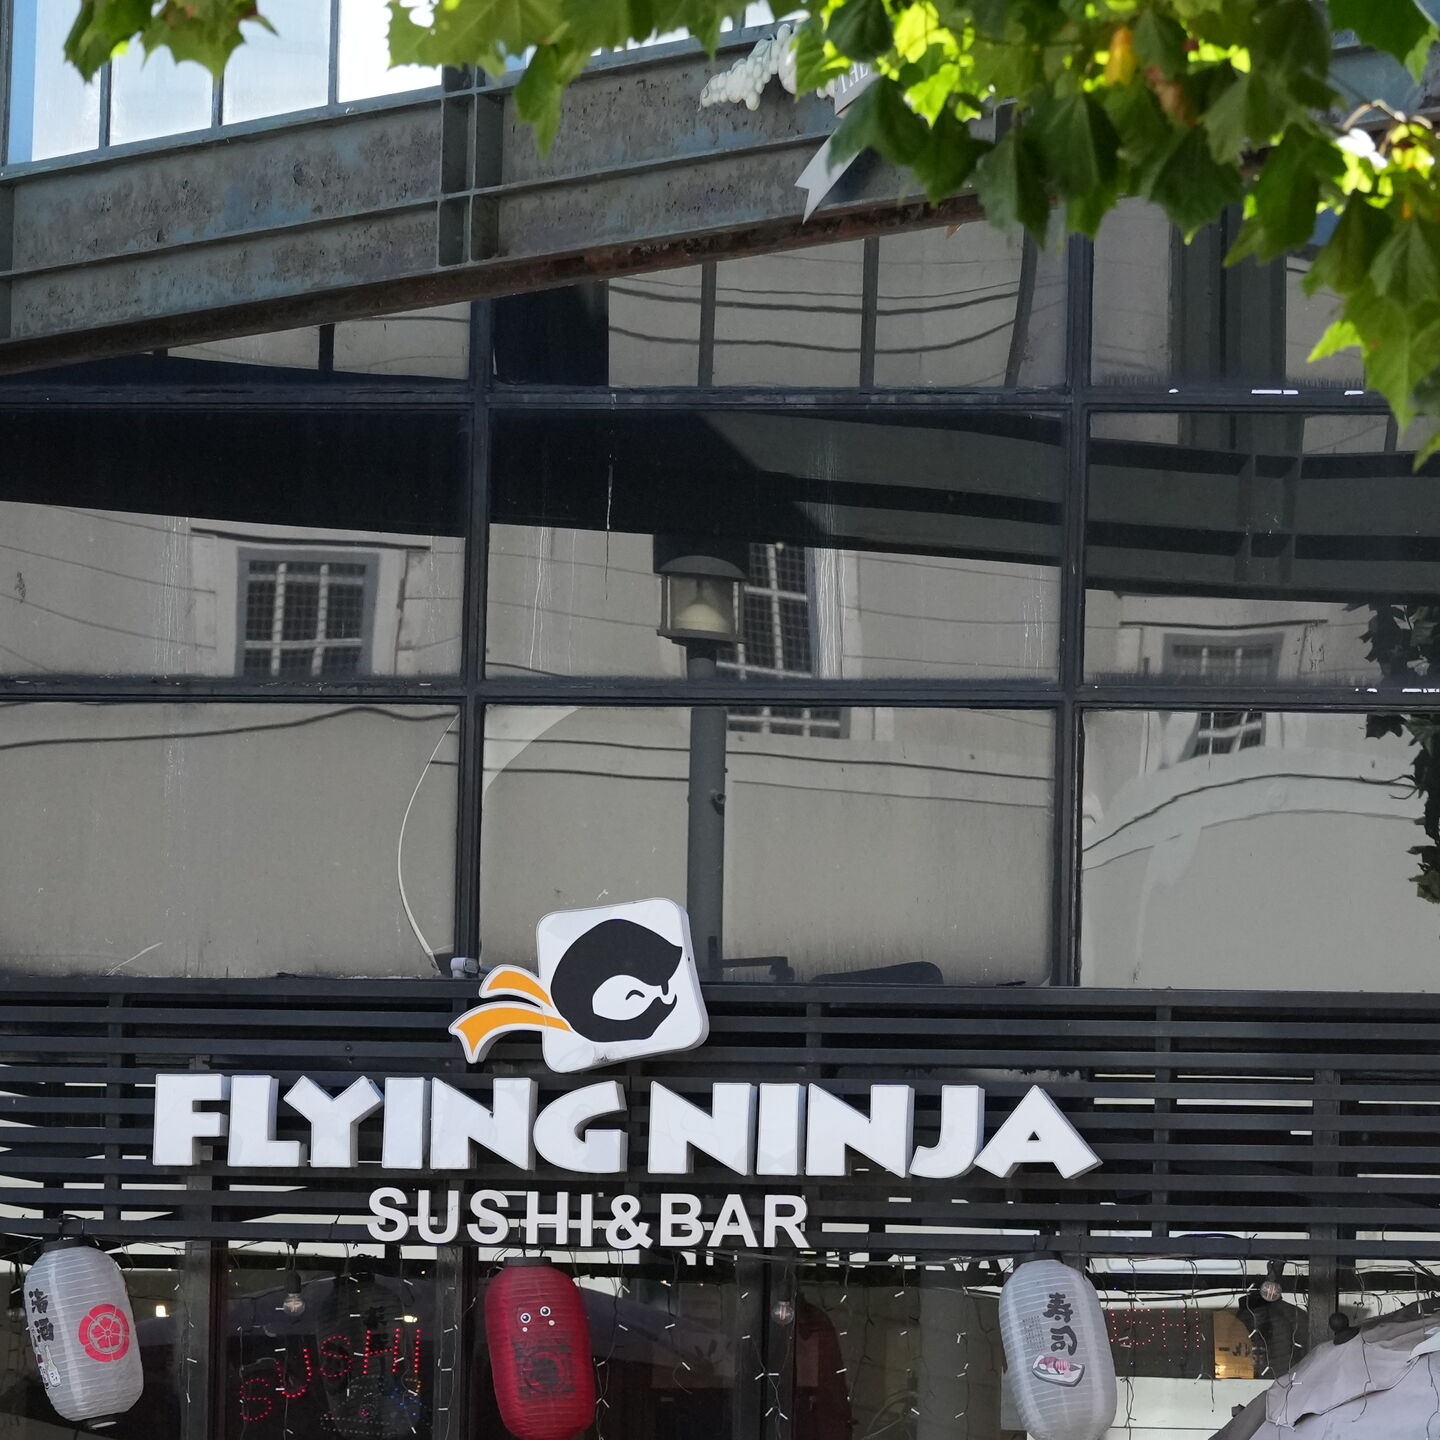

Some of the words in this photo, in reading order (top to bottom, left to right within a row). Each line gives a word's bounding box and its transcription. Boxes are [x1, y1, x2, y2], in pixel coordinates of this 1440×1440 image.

[152, 1073, 627, 1175] FLYING
[648, 1081, 1102, 1180] NINJA
[239, 1328, 421, 1422] SUSHI
